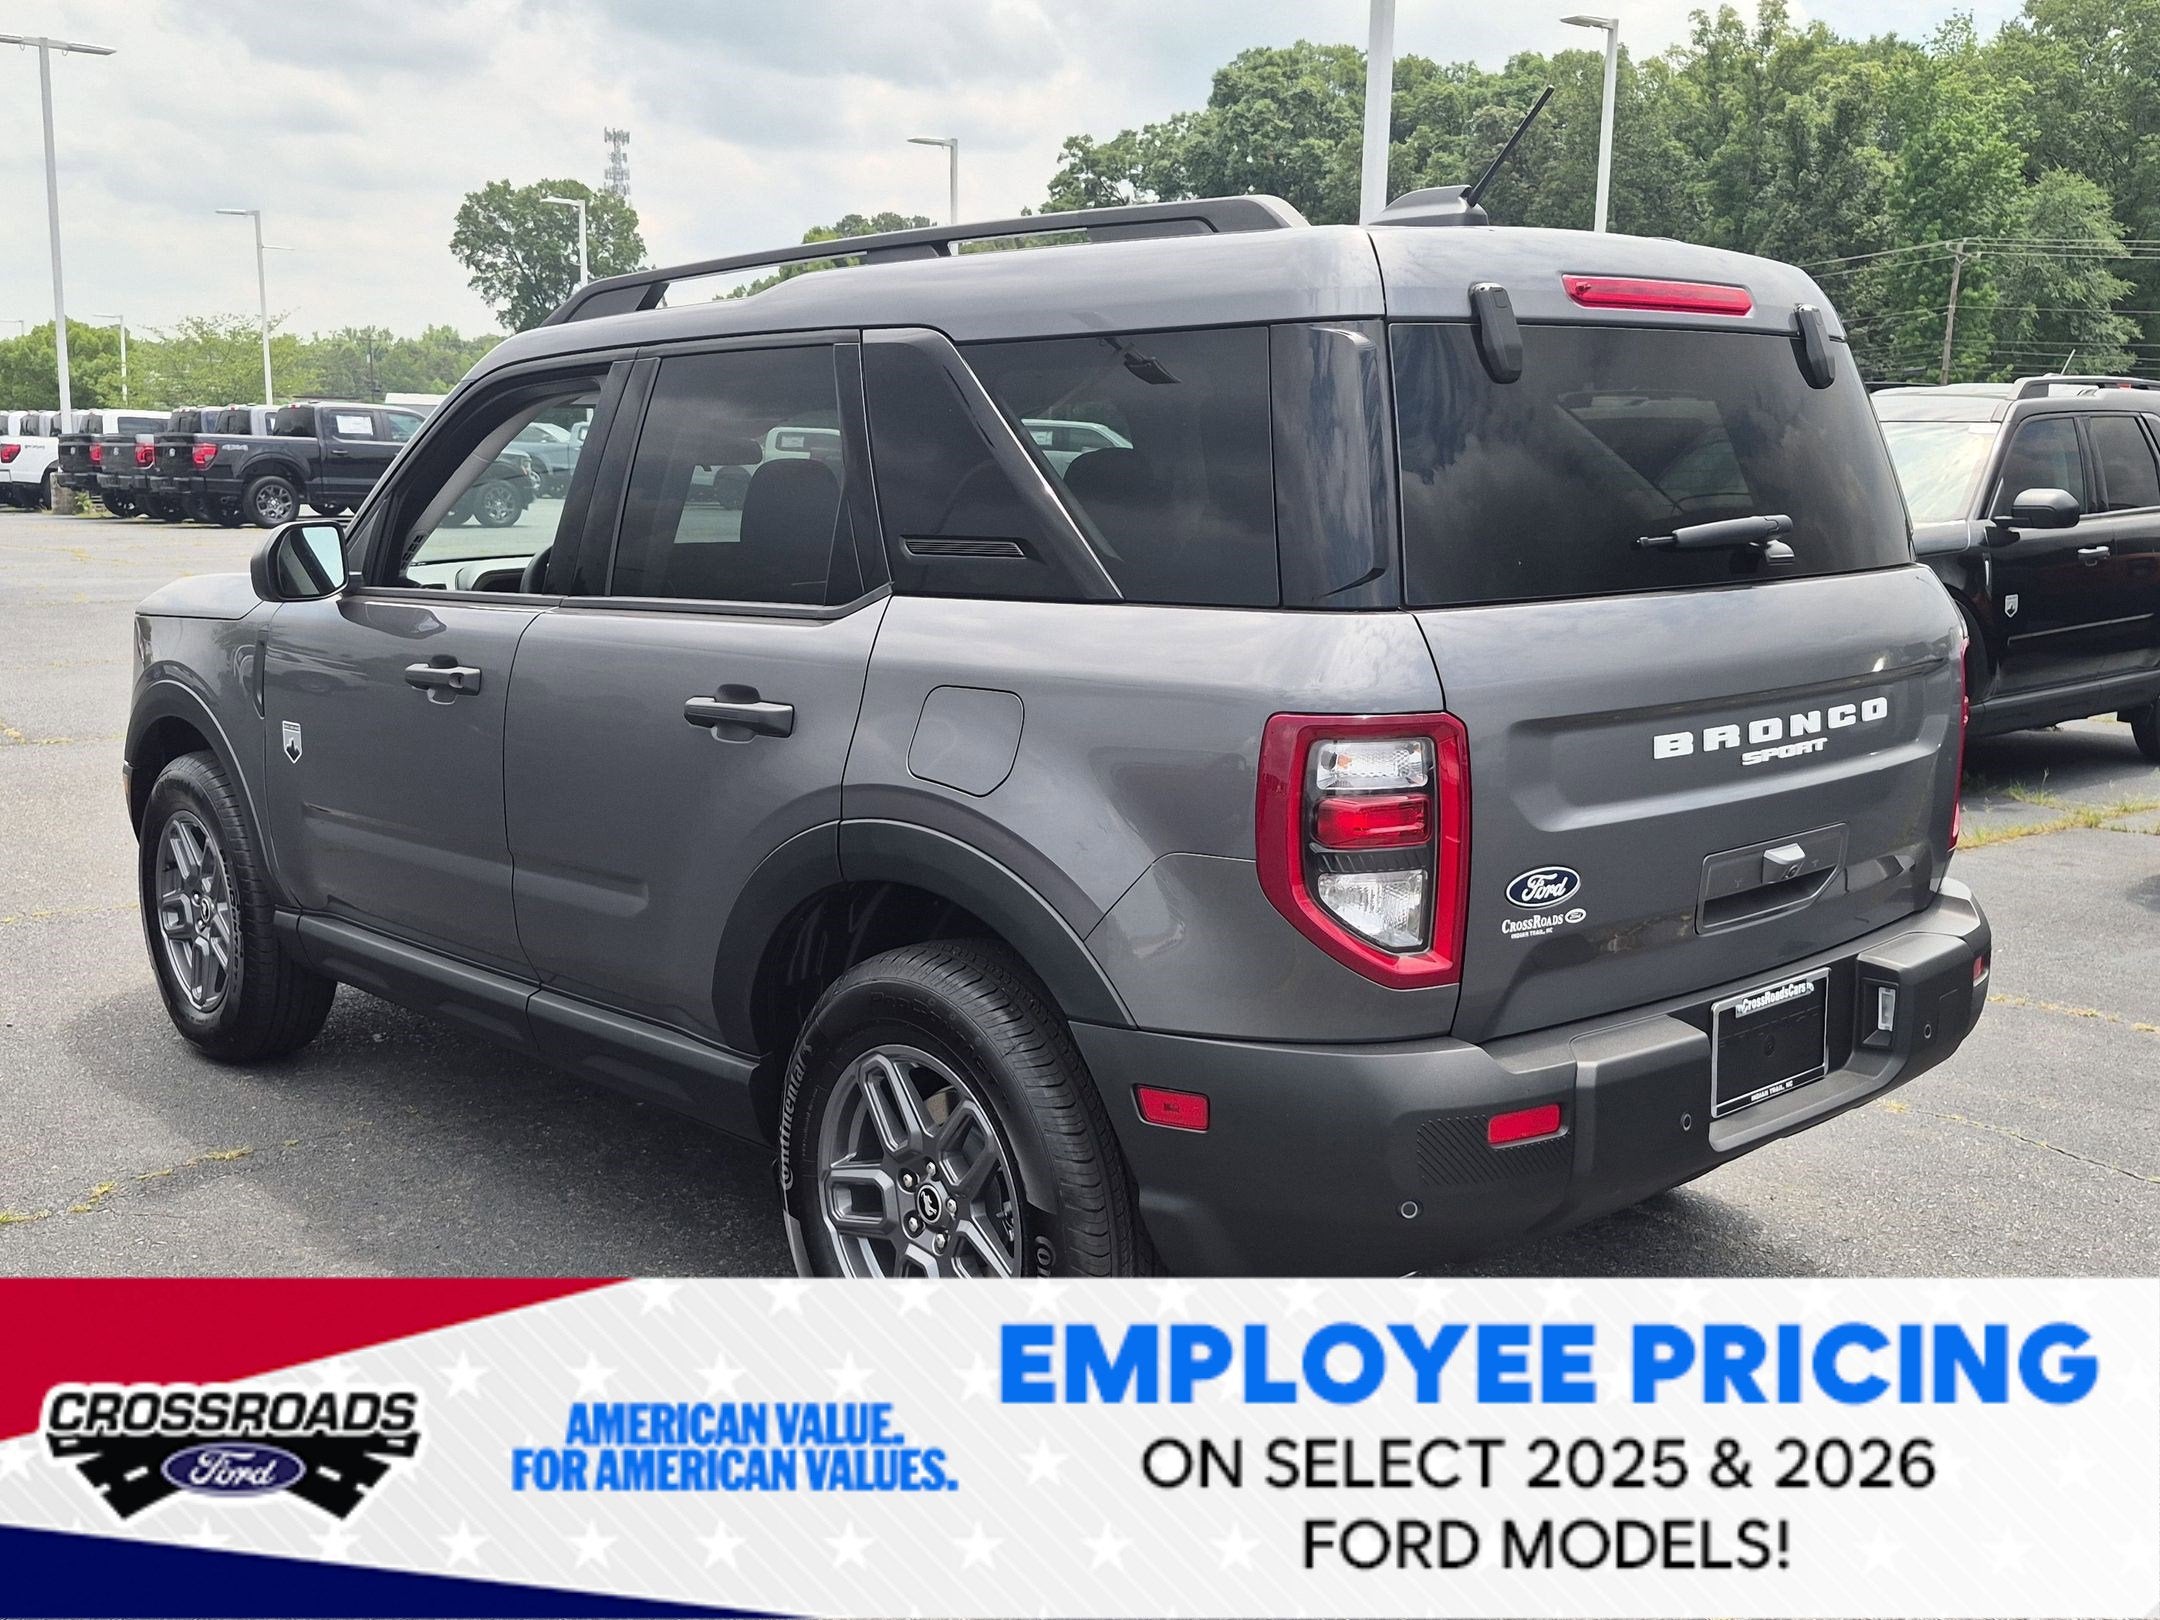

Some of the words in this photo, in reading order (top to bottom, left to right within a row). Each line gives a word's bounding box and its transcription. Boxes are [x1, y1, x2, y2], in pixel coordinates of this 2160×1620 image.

[1653, 696, 1889, 760] BRONCO
[1741, 737, 1829, 766] SPORT
[1521, 872, 1569, 902] Ford
